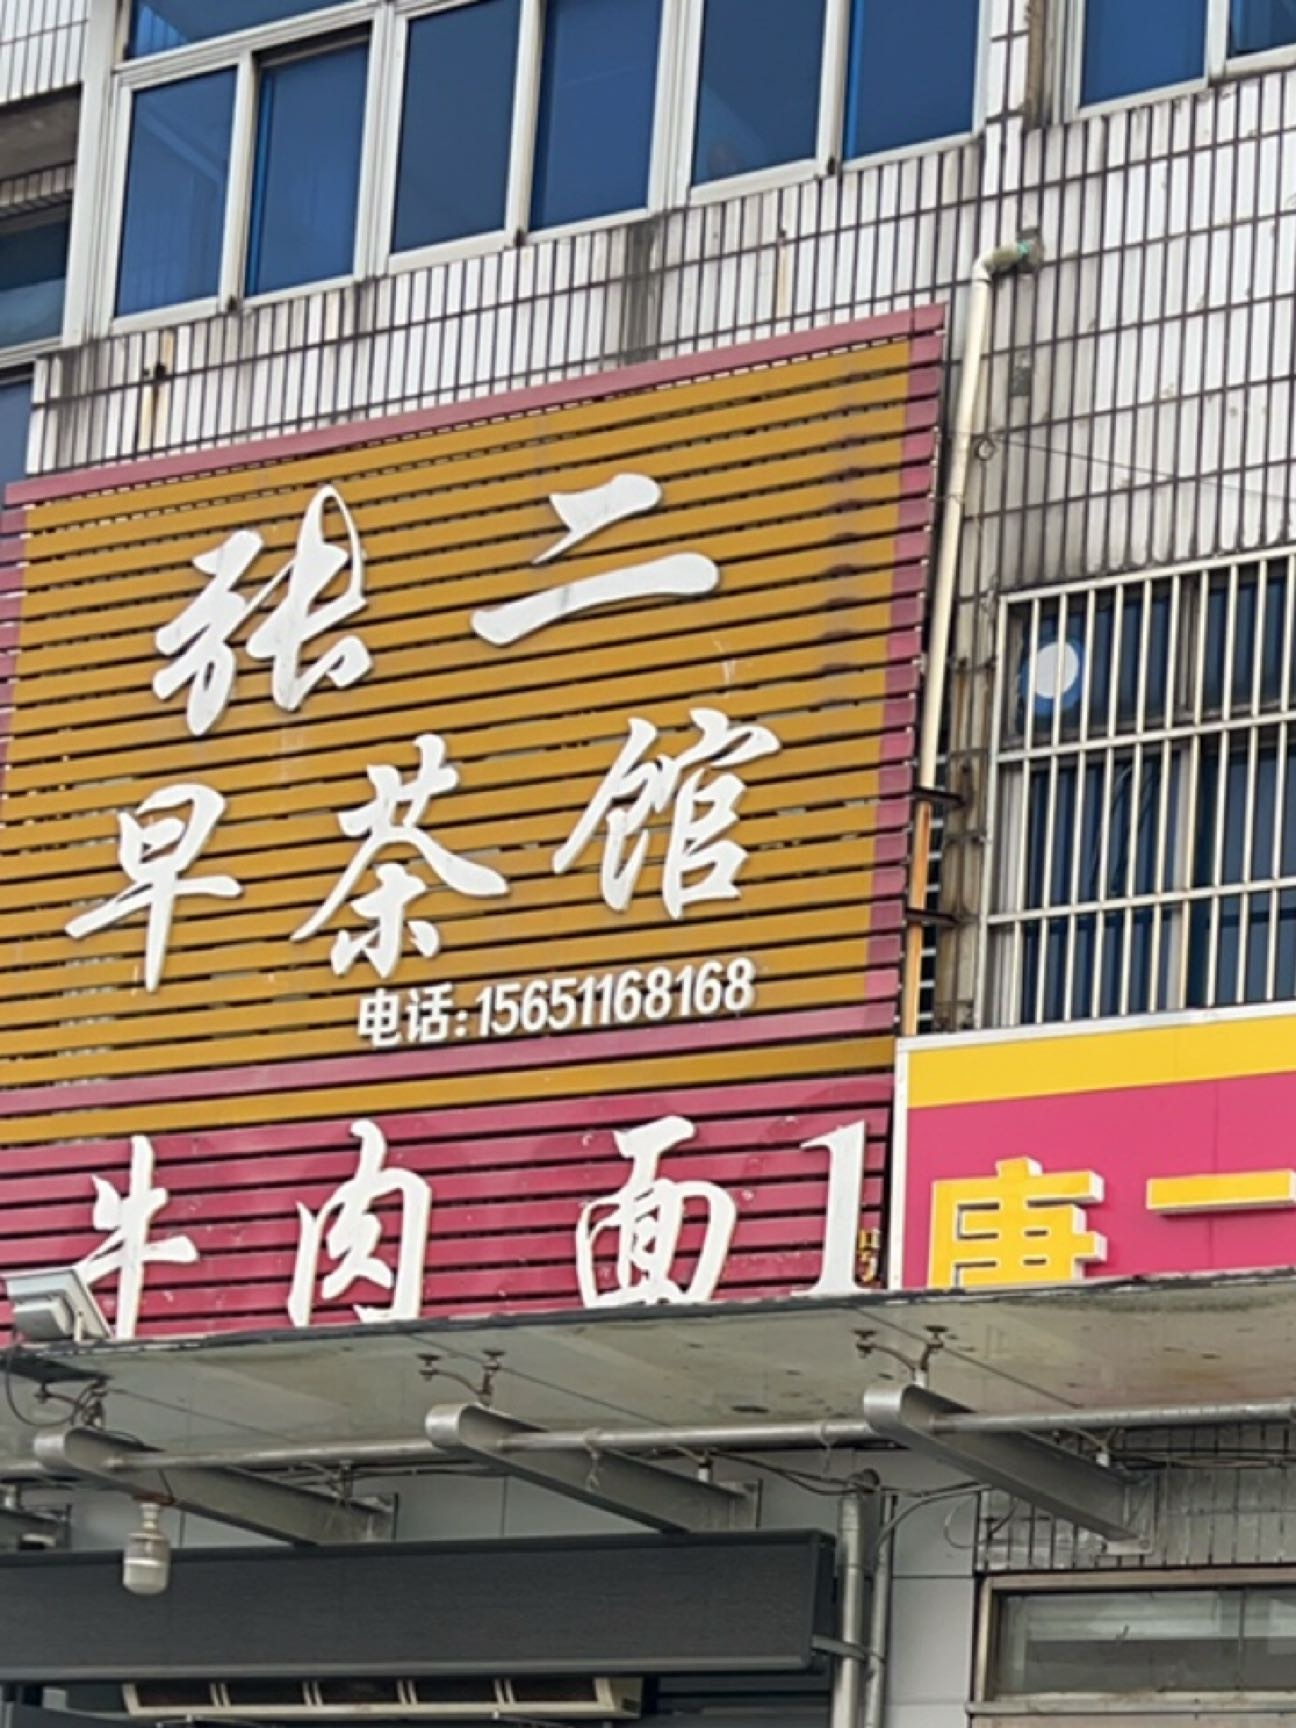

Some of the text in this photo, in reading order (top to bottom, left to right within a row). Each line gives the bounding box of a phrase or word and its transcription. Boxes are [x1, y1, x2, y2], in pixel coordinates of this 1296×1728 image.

[152, 473, 721, 736] 张二
[65, 707, 782, 993] 早茶馆
[357, 957, 757, 1048] 电话:15651168168
